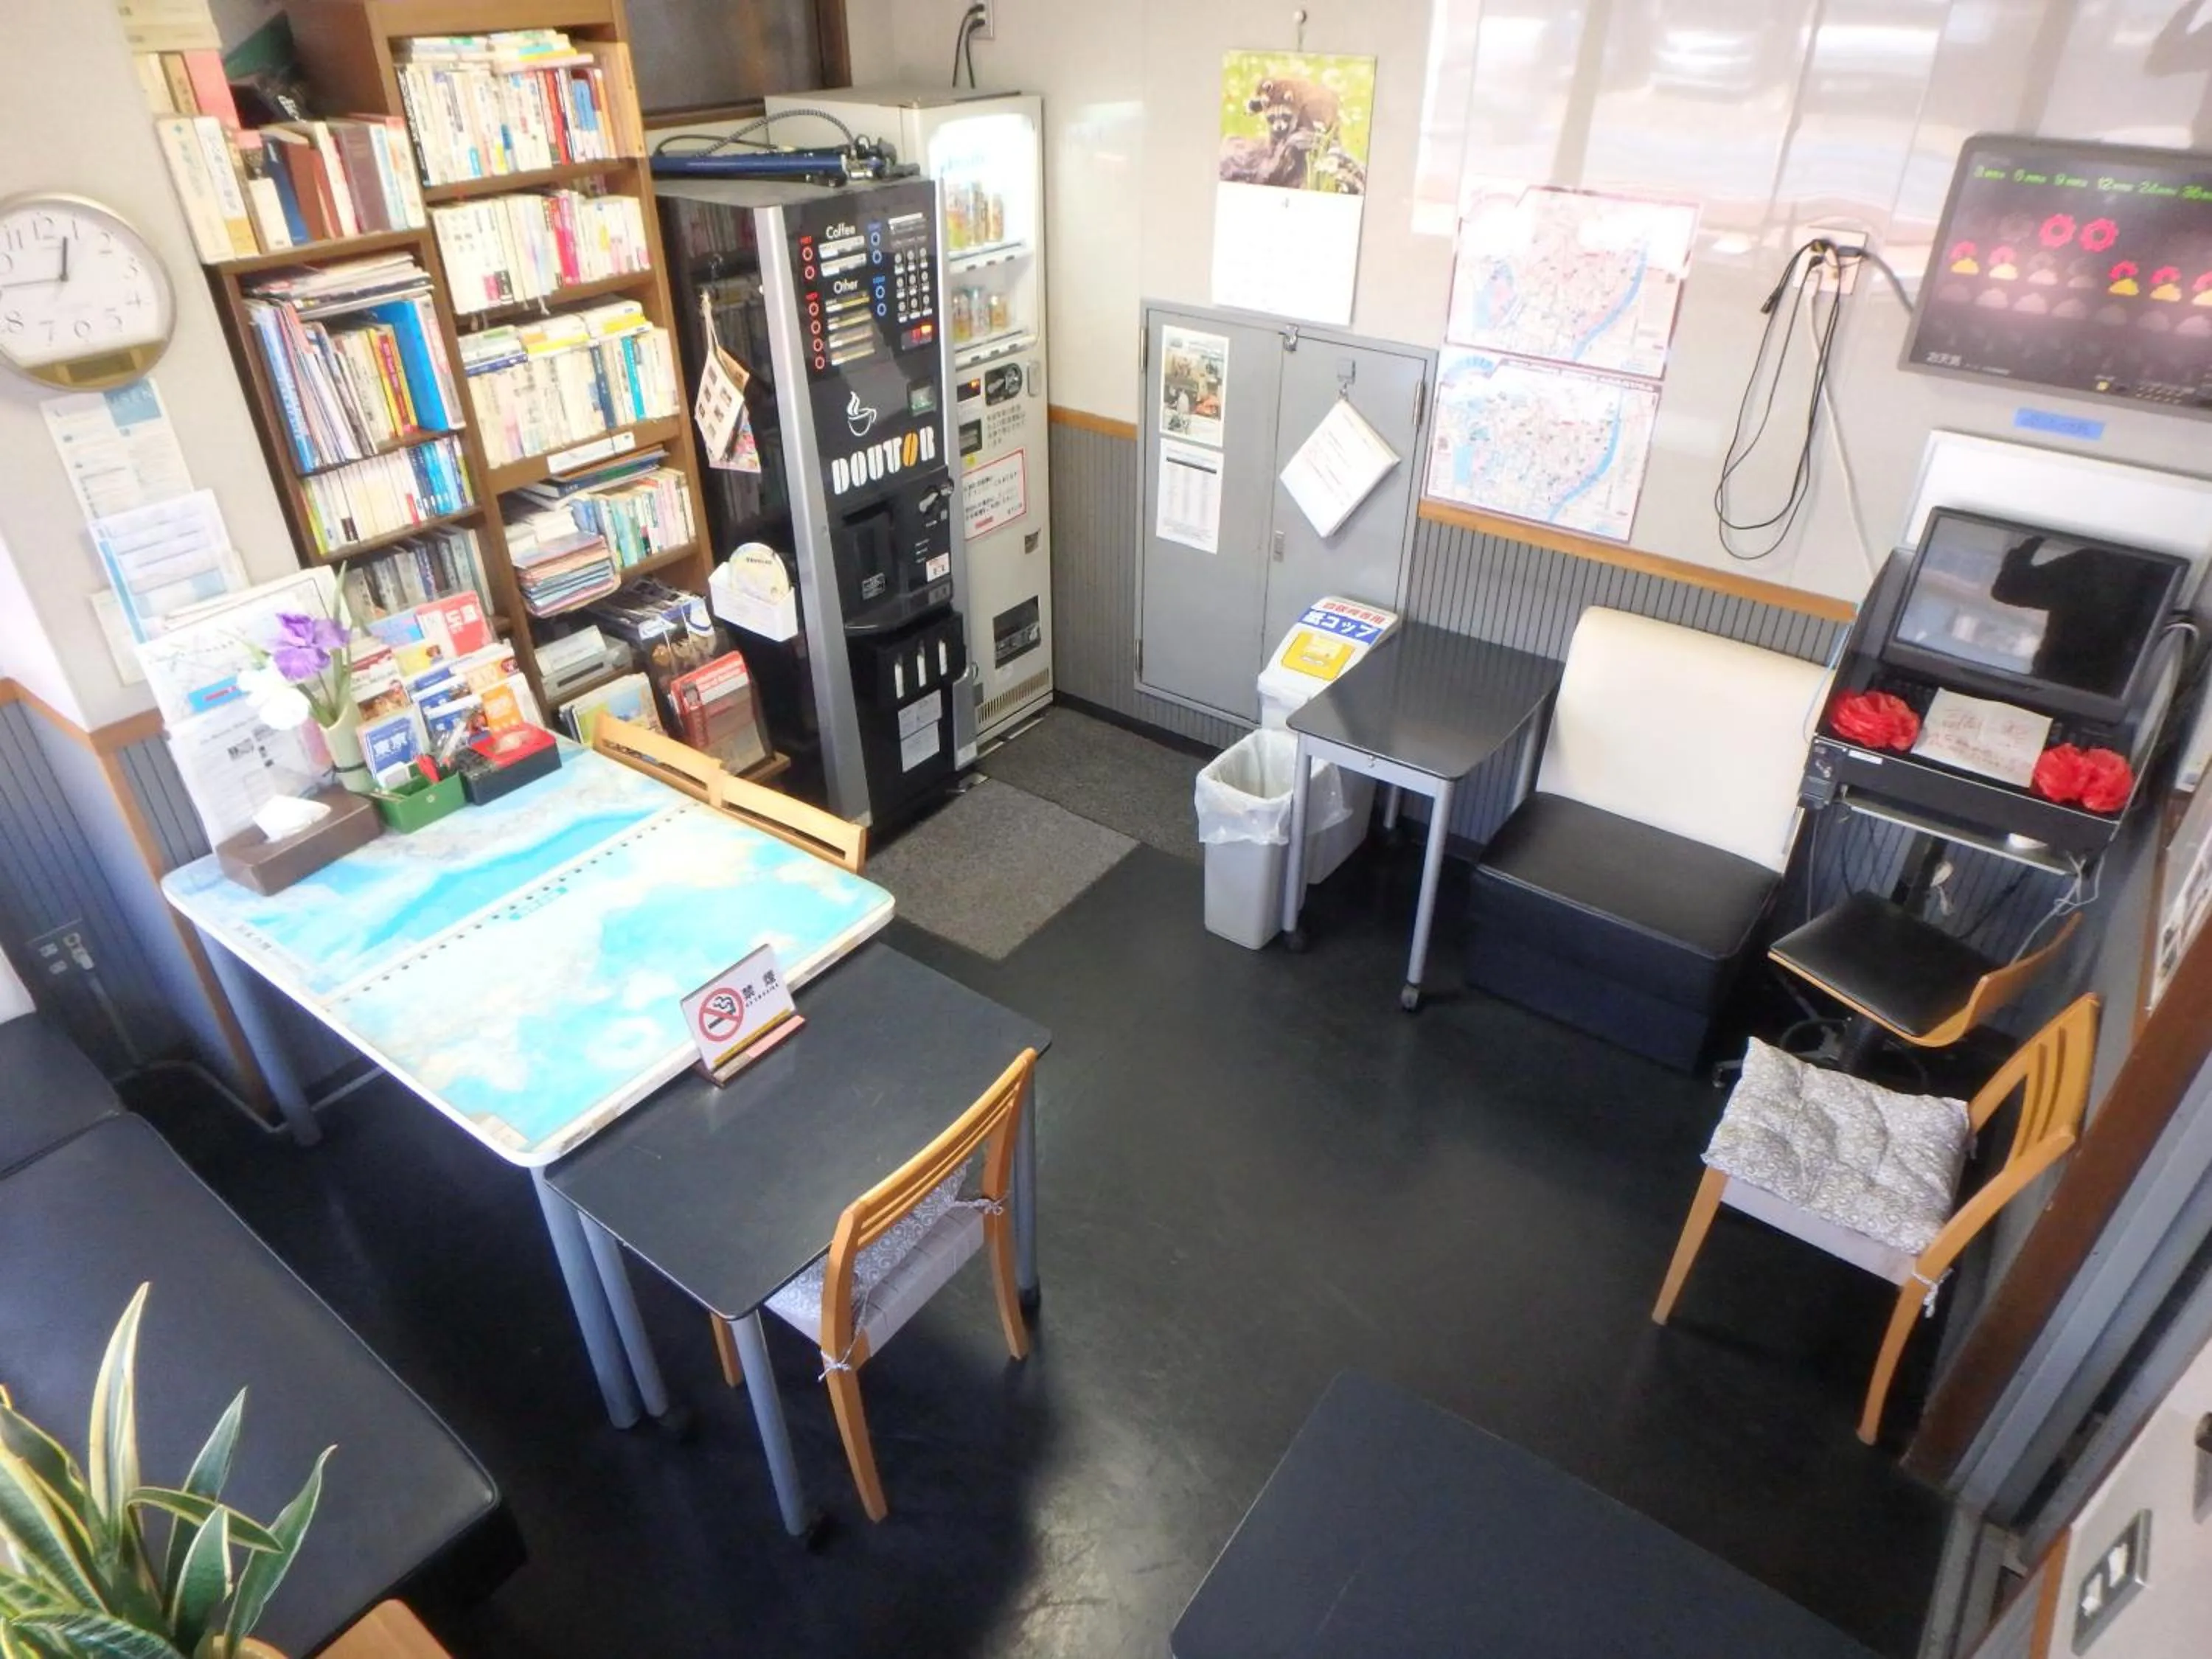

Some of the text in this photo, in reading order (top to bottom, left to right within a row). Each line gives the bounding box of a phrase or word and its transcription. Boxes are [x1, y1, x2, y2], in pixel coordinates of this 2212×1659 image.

[6, 229, 23, 251] 11
[32, 219, 56, 240] 12
[72, 220, 79, 240] 1
[826, 222, 855, 239] Coffee
[99, 232, 112, 254] 2
[833, 279, 858, 293] Other
[125, 291, 142, 308] 4
[6, 310, 24, 333] 8
[38, 319, 55, 345] 7
[831, 425, 936, 495] DOUTOR
